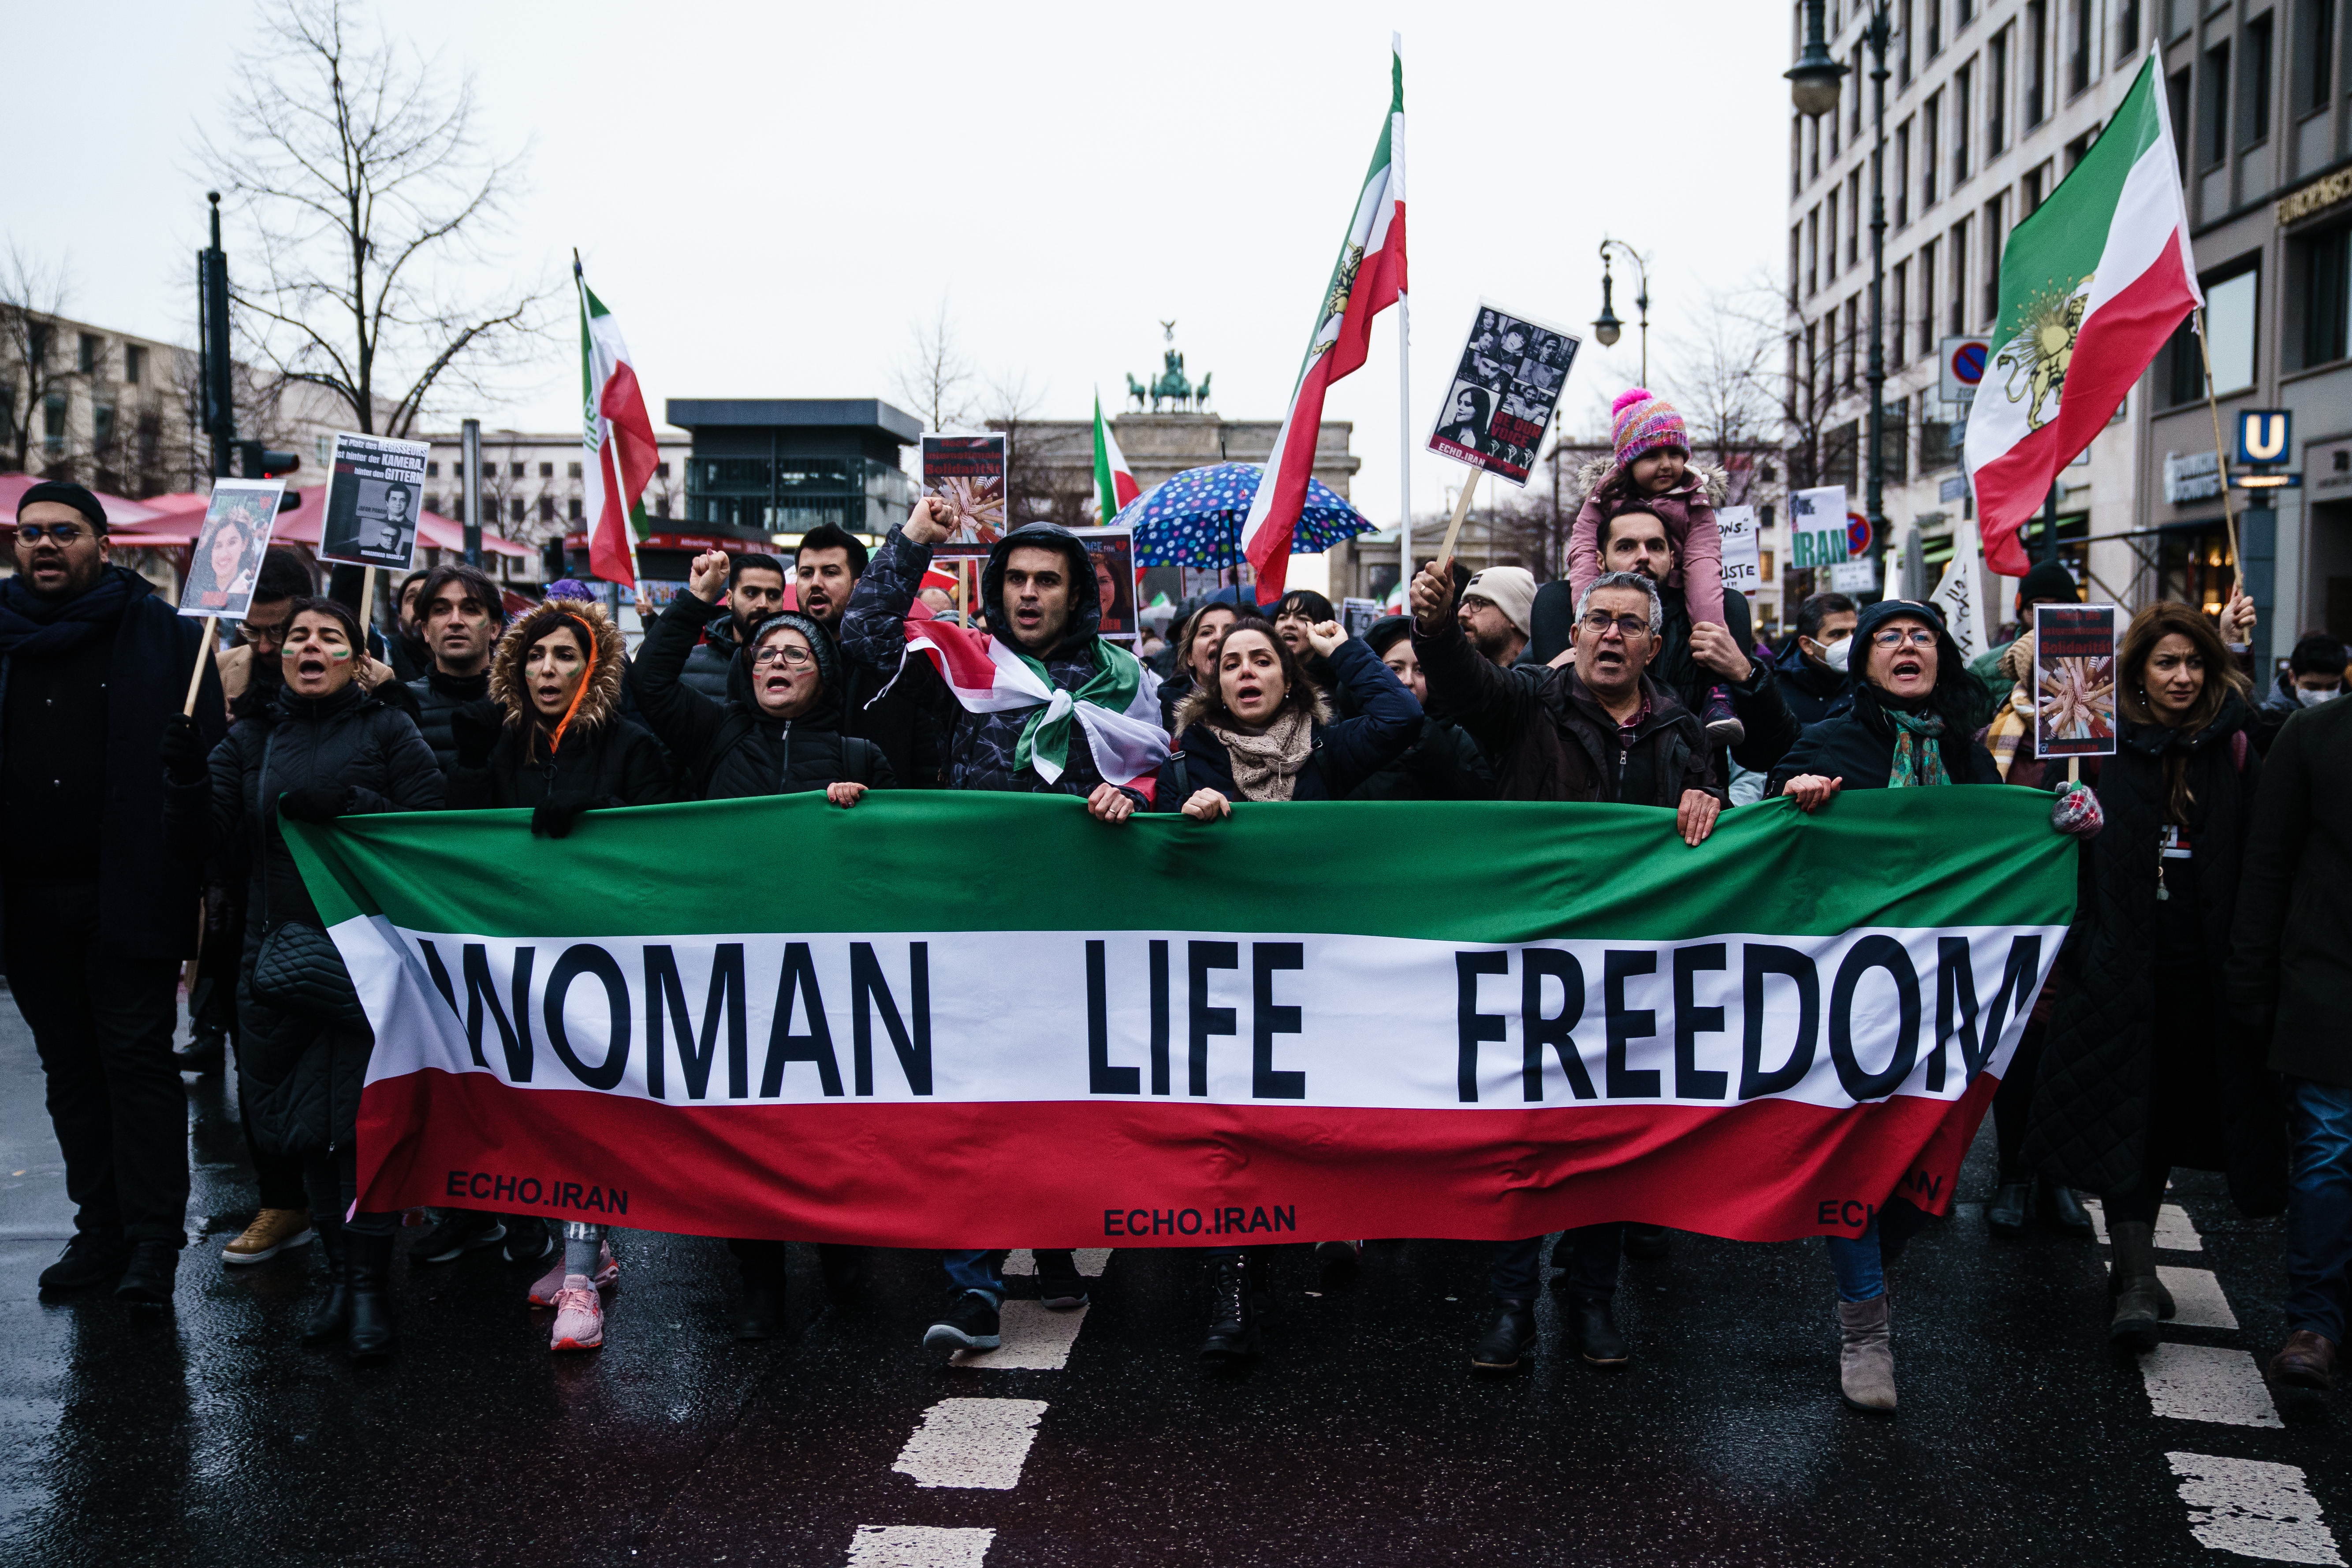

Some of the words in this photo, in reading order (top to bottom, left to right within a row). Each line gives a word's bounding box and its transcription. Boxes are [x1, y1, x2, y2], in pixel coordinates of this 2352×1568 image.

[1491, 423, 1528, 448] VOICE
[1494, 412, 1512, 429] BE
[1515, 418, 1542, 439] OUR
[2245, 414, 2285, 460] U
[346, 451, 368, 462] hinter
[368, 455, 381, 464] der
[349, 439, 365, 449] Platz
[365, 441, 378, 450] des
[378, 440, 428, 458] REGISSEURS
[1438, 442, 1486, 468] ECHO.IRAN
[354, 466, 373, 477] hinter
[373, 470, 384, 479] den
[384, 468, 423, 484] GITTERN
[925, 463, 1002, 474] Solidarität
[1793, 529, 1847, 568] IRAN
[2041, 639, 2112, 654] Solidarität
[417, 937, 934, 1100] WOMAN
[1085, 939, 1306, 1100] LIFE
[1454, 934, 2043, 1103] FREEDOM
[446, 1170, 629, 1217] ECHO.IRAN
[1104, 1204, 1296, 1237] ECHO.IRAN
